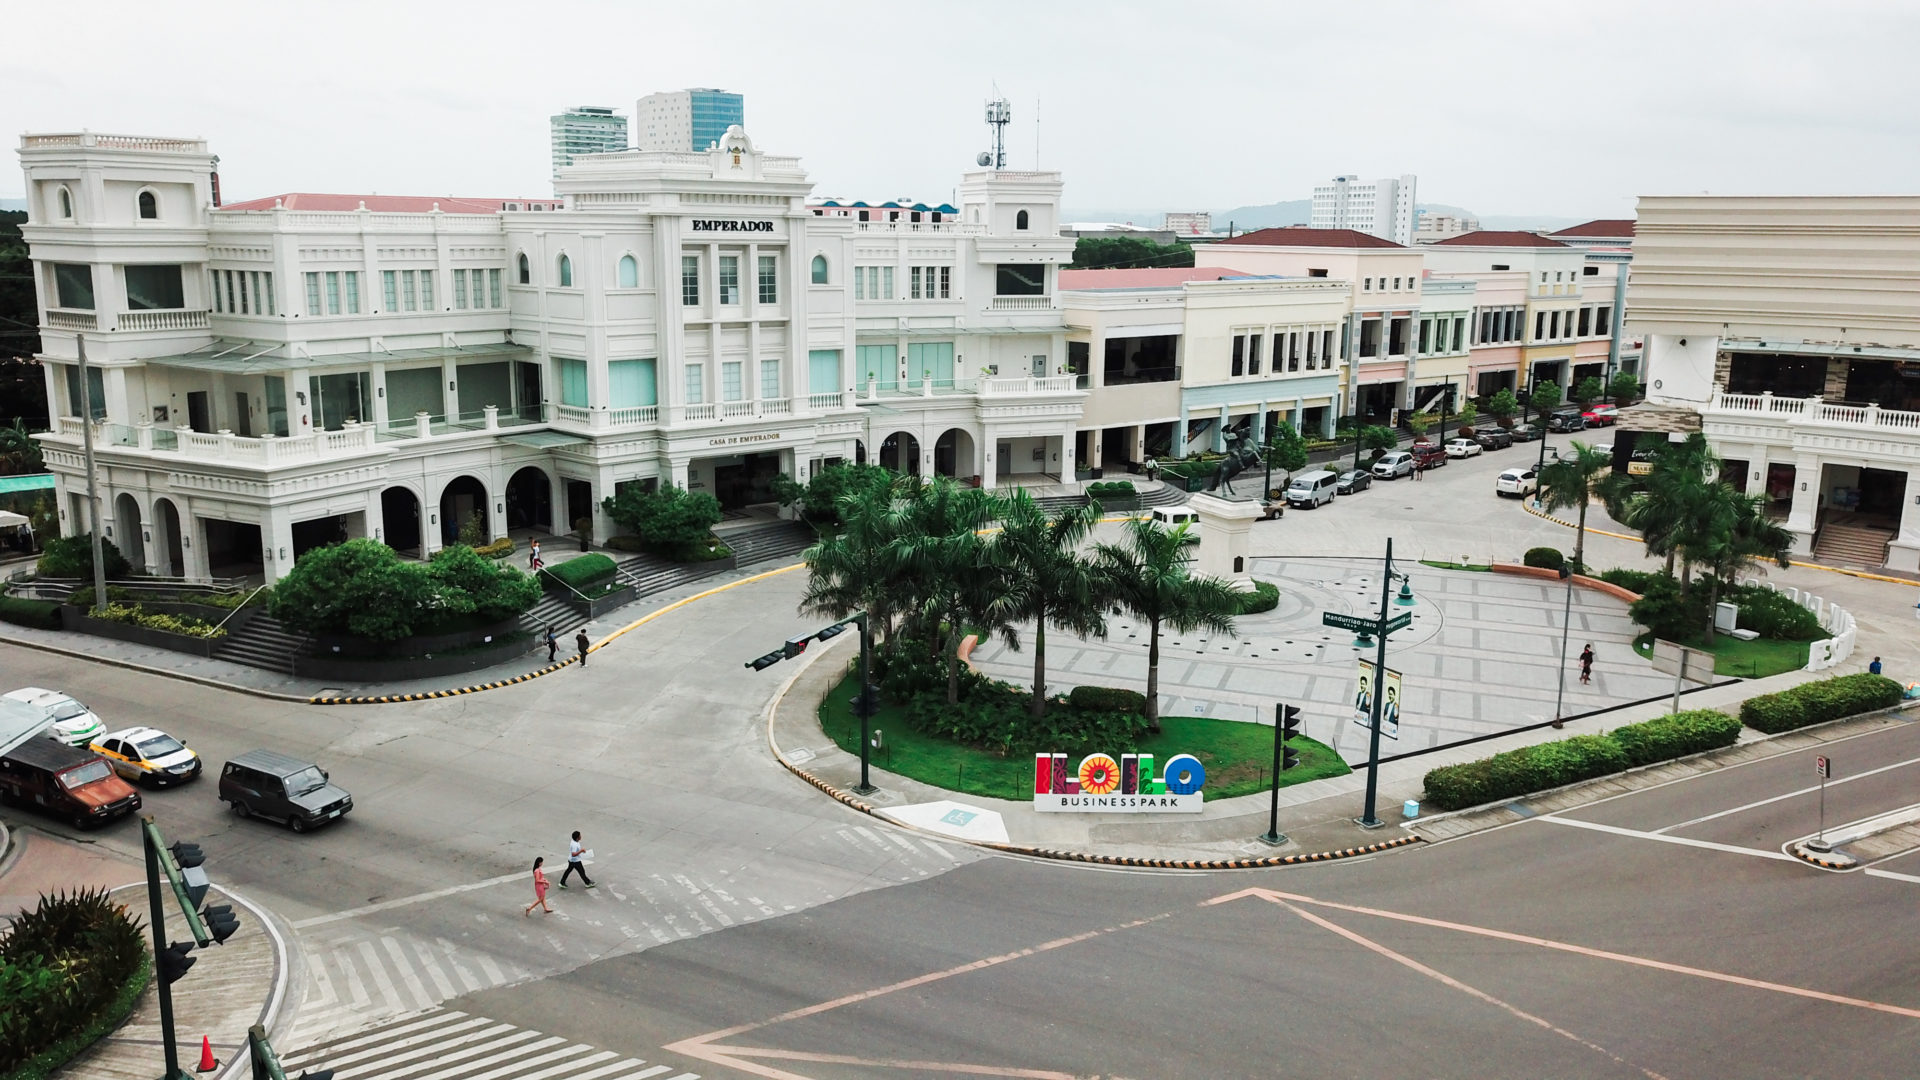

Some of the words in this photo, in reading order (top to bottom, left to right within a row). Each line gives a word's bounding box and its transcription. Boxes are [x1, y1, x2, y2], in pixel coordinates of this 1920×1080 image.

[692, 219, 774, 232] EMPERADOR
[709, 438, 726, 446] CASA
[740, 432, 781, 443] EMPERADOR
[1035, 752, 1206, 795] ILOILO
